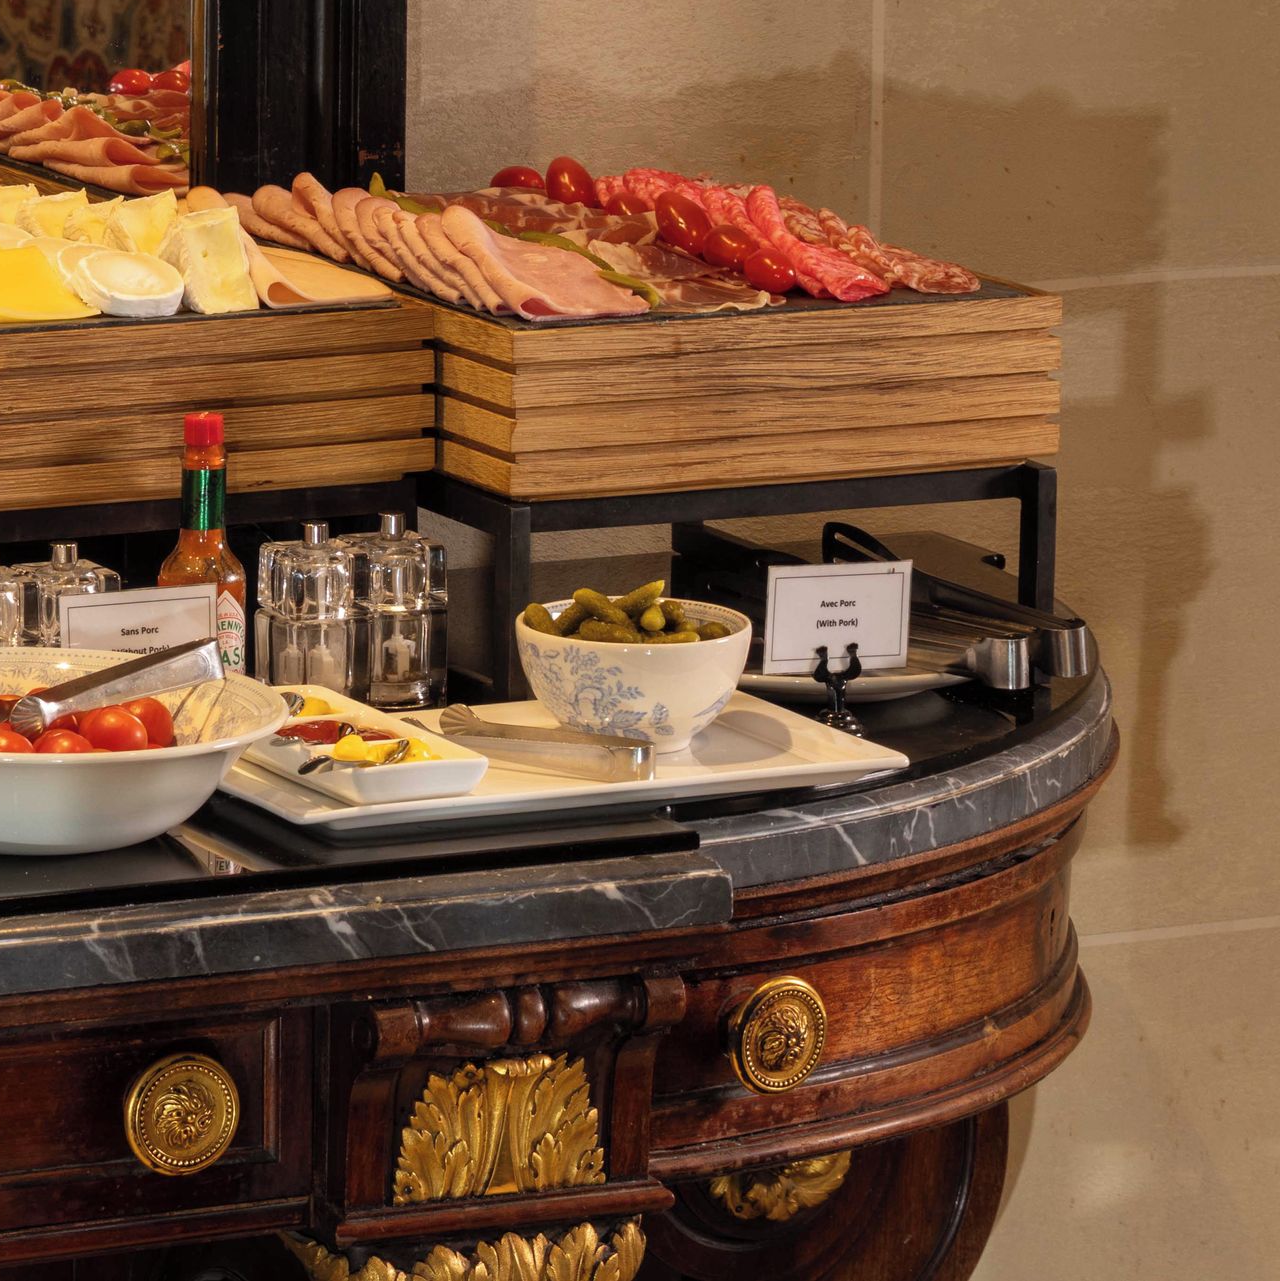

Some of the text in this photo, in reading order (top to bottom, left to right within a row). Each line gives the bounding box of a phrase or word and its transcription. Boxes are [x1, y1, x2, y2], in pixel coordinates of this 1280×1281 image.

[820, 599, 856, 608] Avec Porc
[816, 618, 858, 629] (With Pork)
[120, 626, 160, 636] Sans Porc
